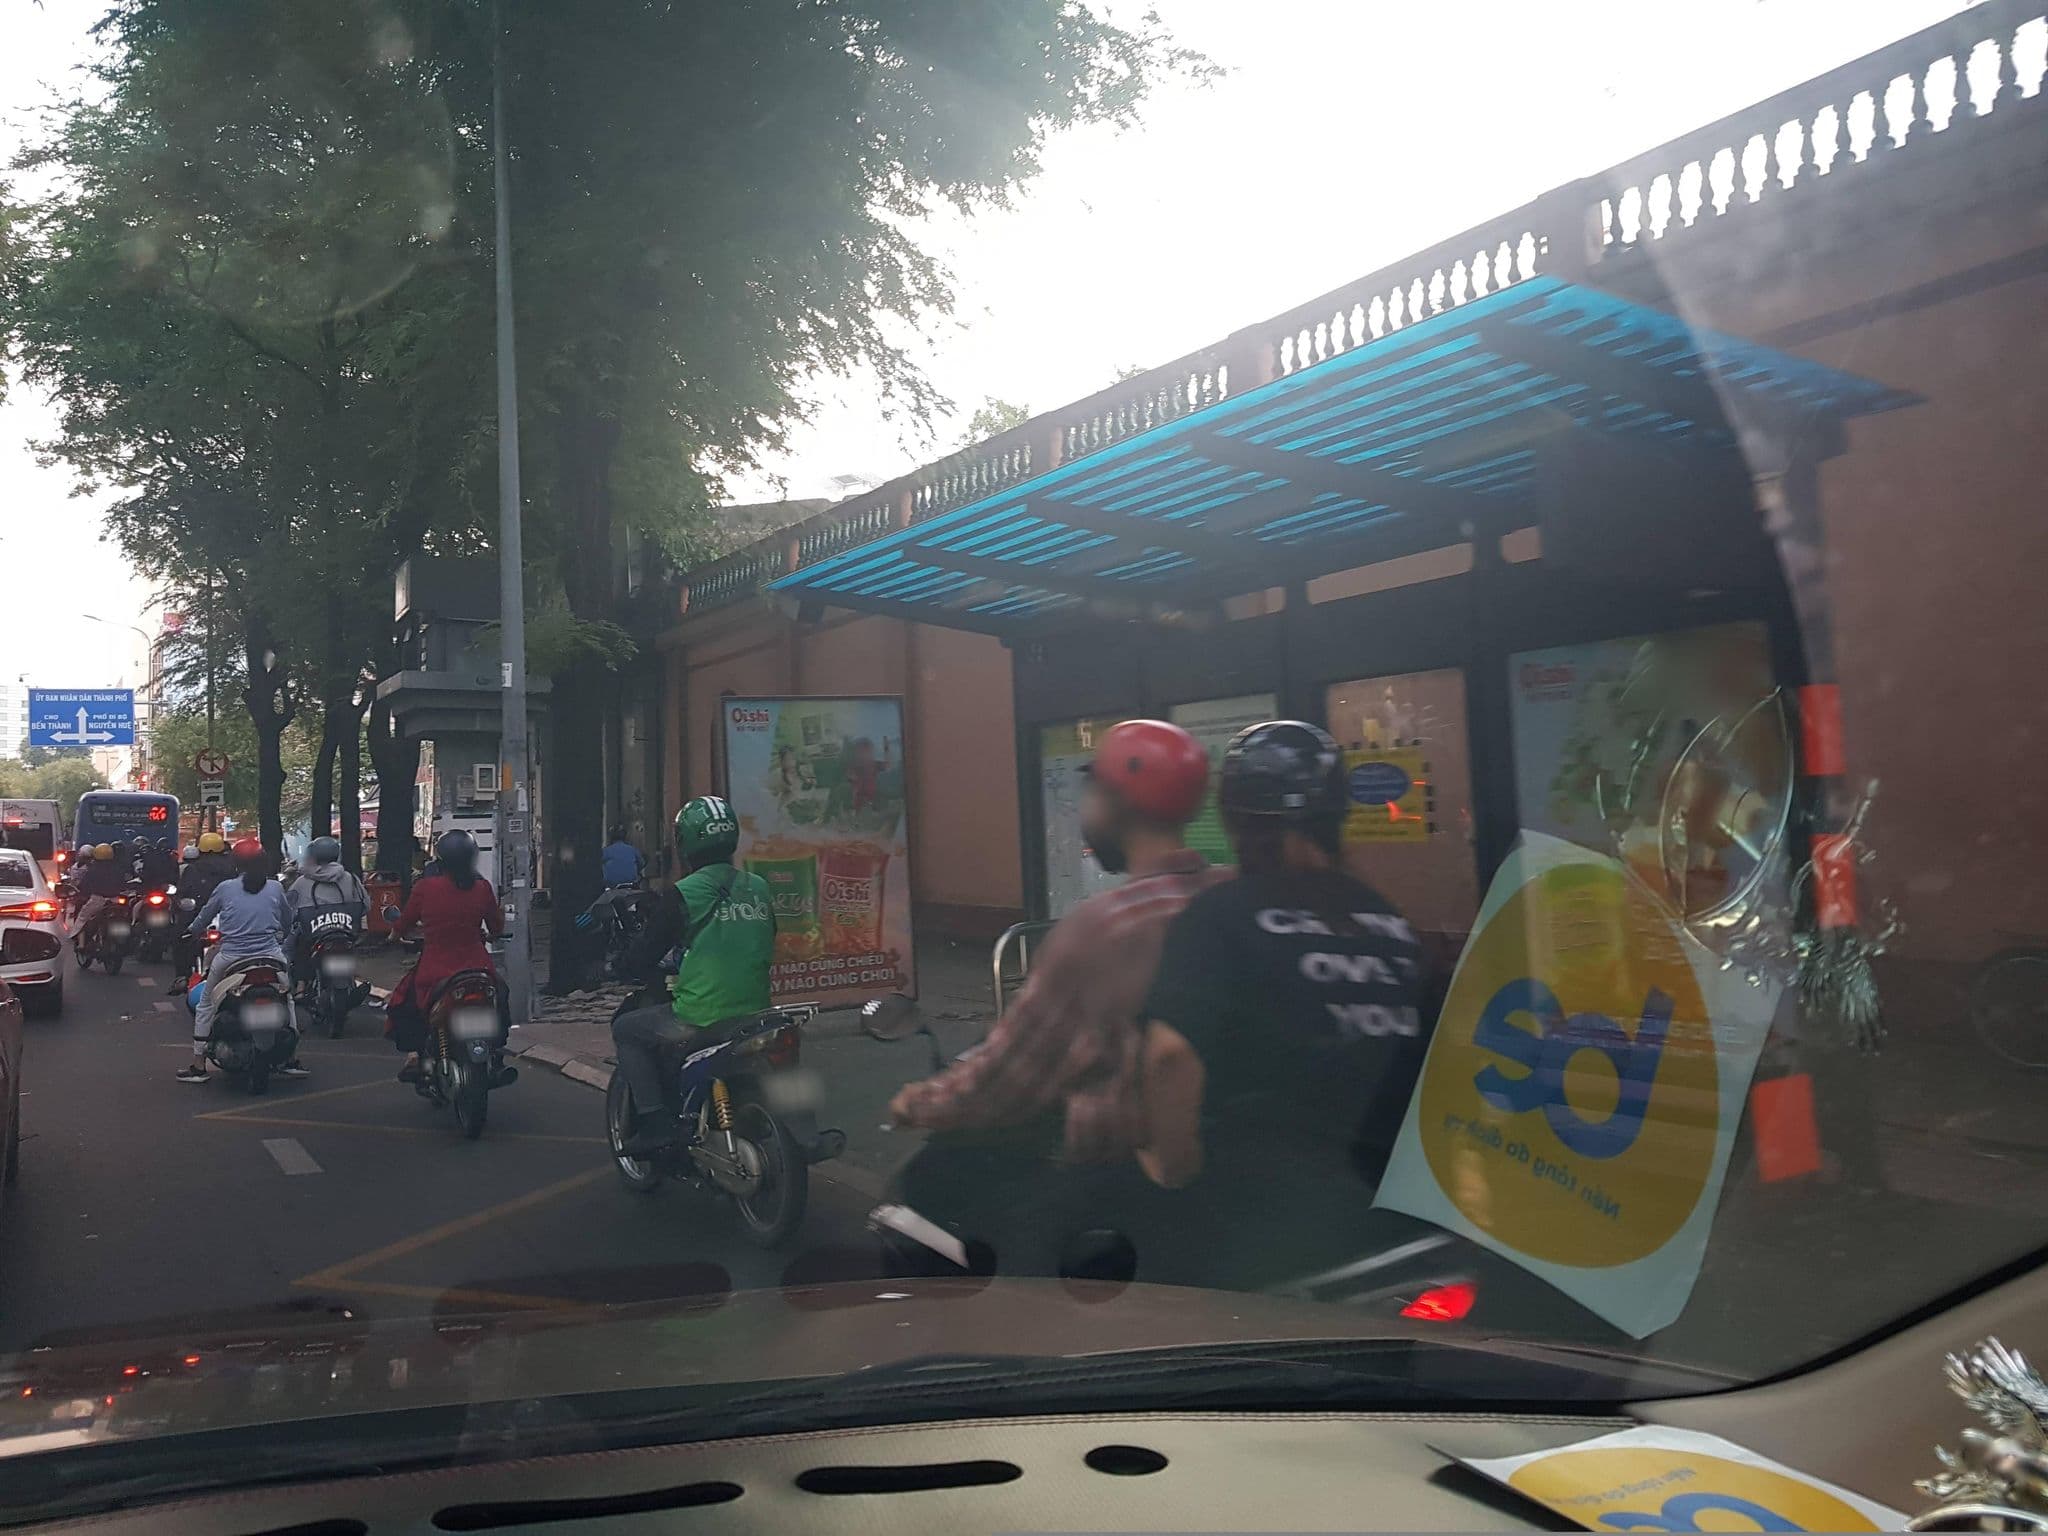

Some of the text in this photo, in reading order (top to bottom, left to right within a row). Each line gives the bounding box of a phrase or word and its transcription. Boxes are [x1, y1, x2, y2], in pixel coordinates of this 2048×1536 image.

[45, 694, 57, 702] BAN
[59, 693, 77, 702] NHÂN
[93, 693, 113, 702] THÀNH
[114, 692, 129, 702] PHỐ
[732, 707, 769, 724] Oishi
[31, 720, 72, 730] BẾN THÀNH
[706, 819, 736, 835] Grab
[825, 879, 872, 902] Oishi
[310, 912, 353, 934] LEAGUE
